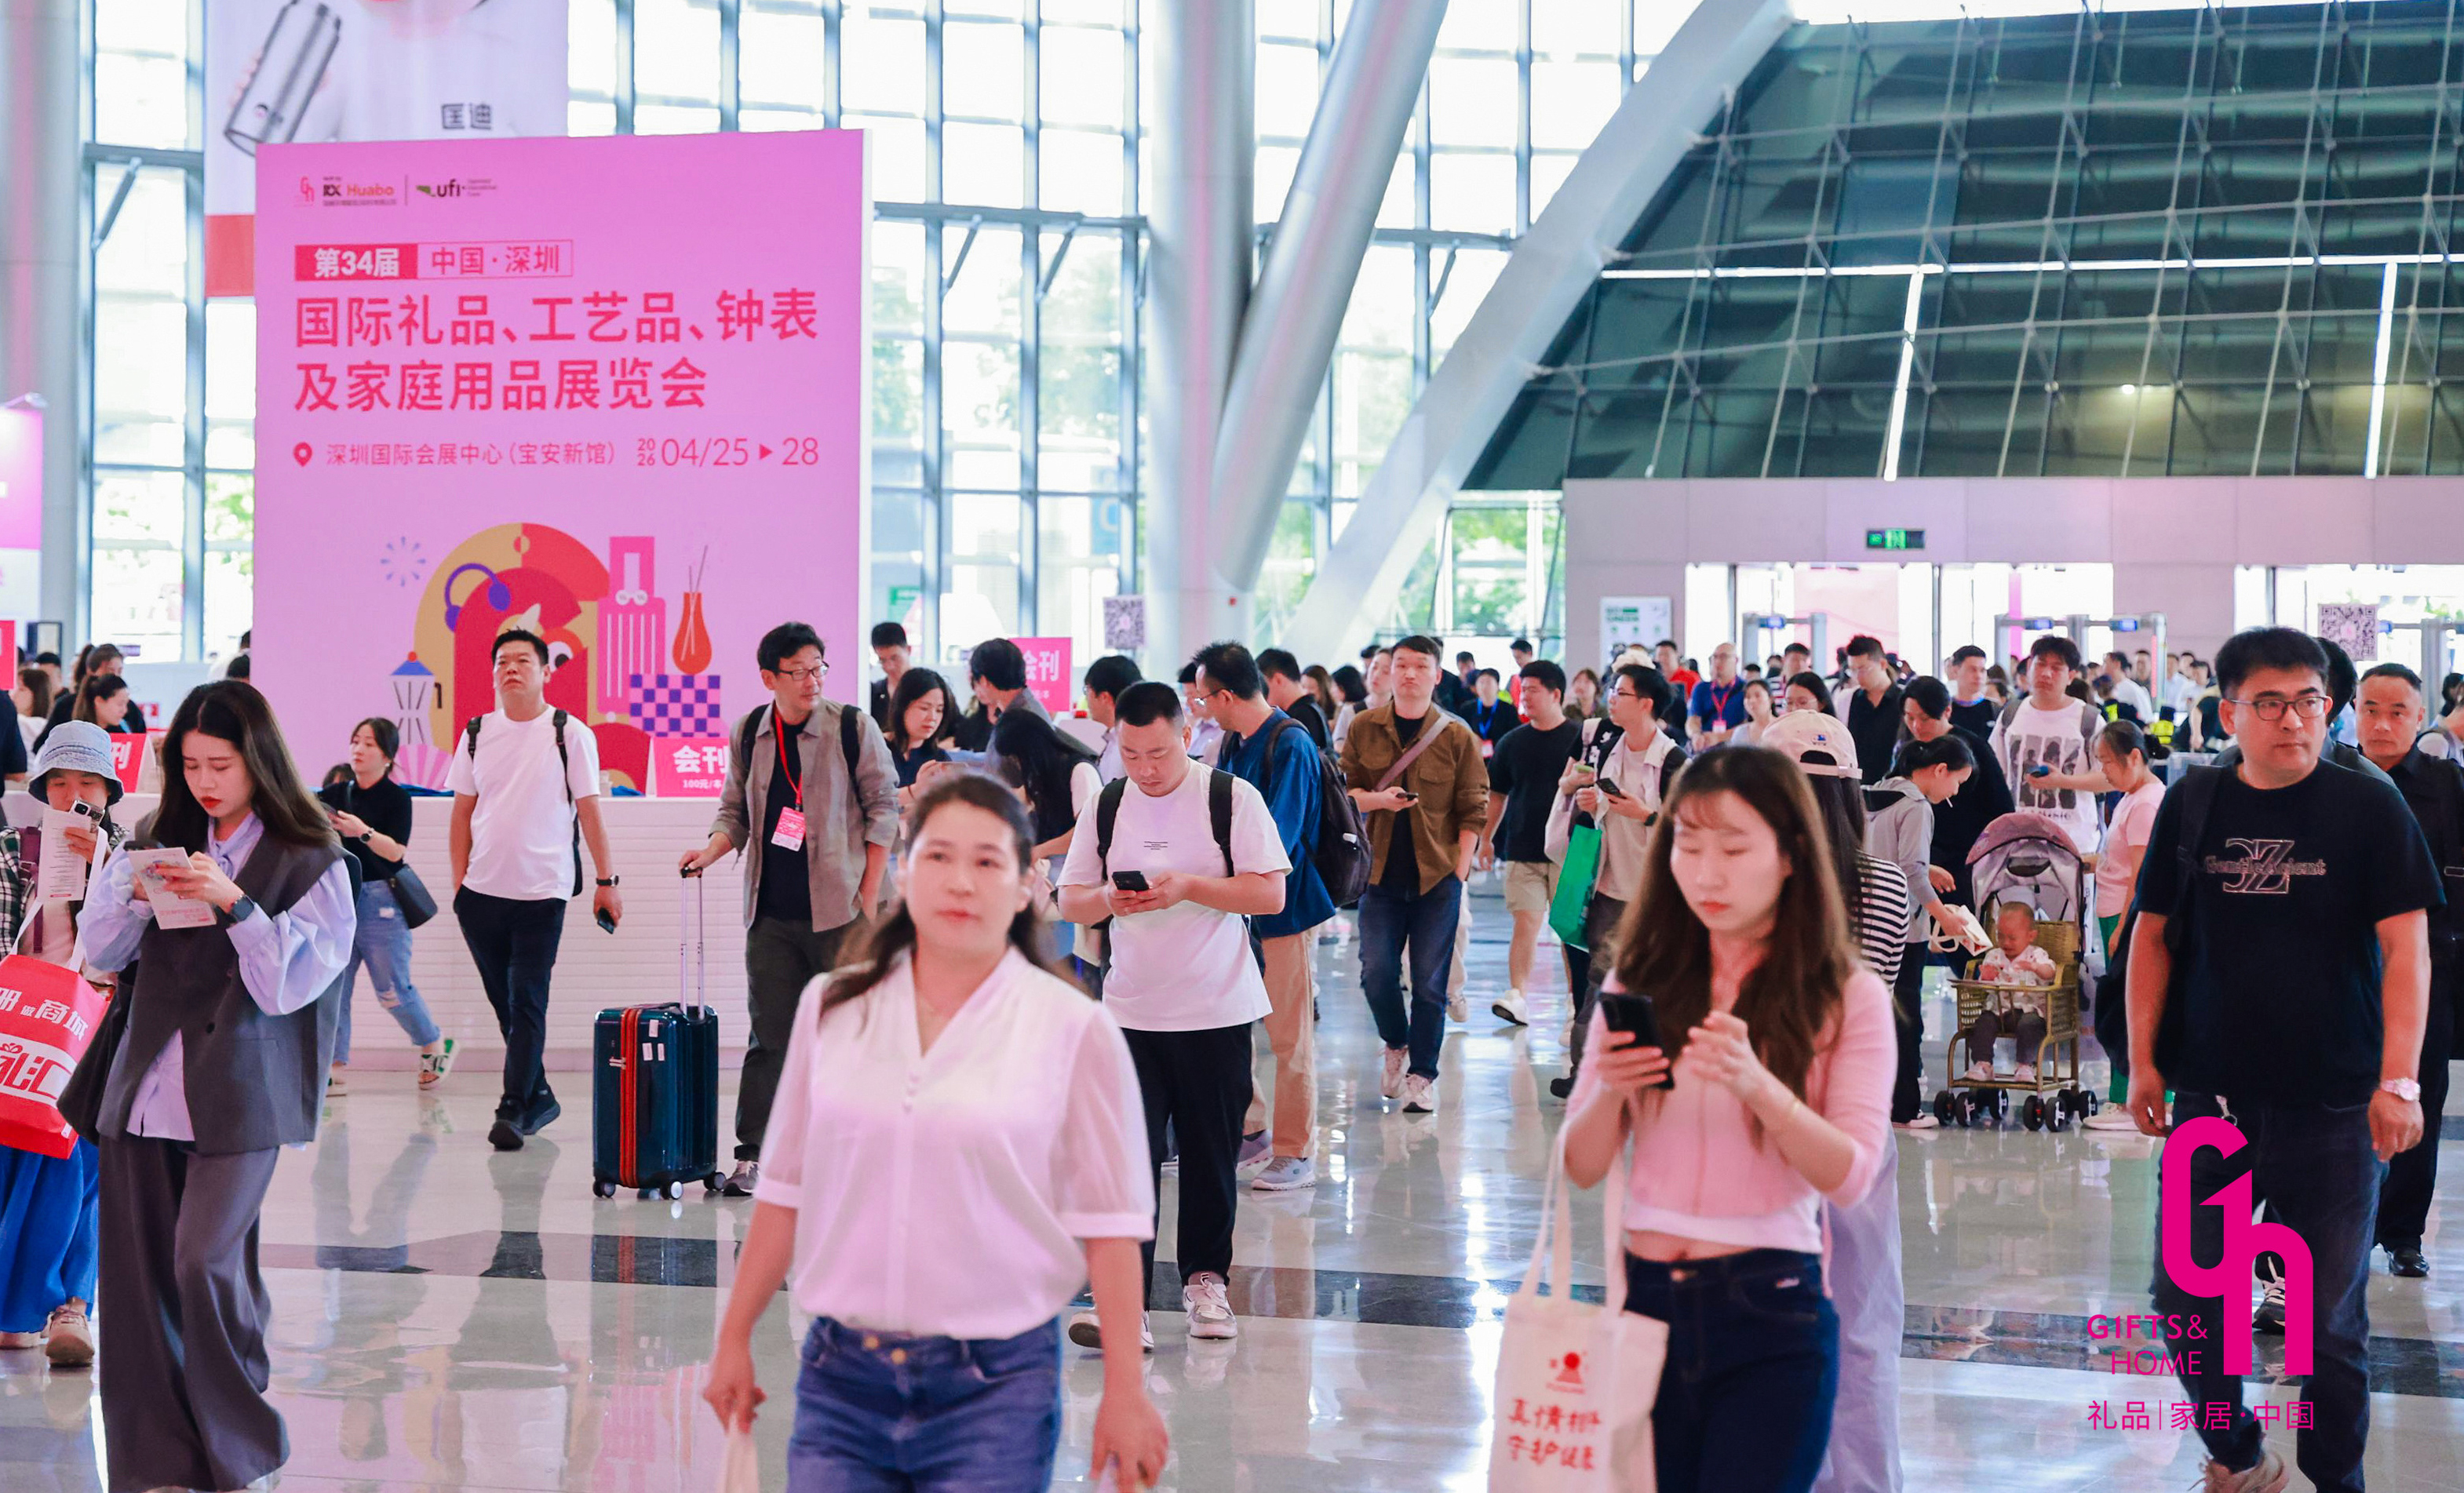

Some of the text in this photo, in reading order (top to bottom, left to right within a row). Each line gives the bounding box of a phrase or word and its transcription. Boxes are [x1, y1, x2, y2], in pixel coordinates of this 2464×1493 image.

[346, 184, 394, 196] Huabo
[314, 247, 399, 278] 第34届
[297, 288, 818, 348] 国际礼品、工艺品、钟表
[294, 356, 707, 412] 及家庭用品展览会
[662, 437, 819, 468] 04/25 28
[672, 745, 729, 774] 会刊
